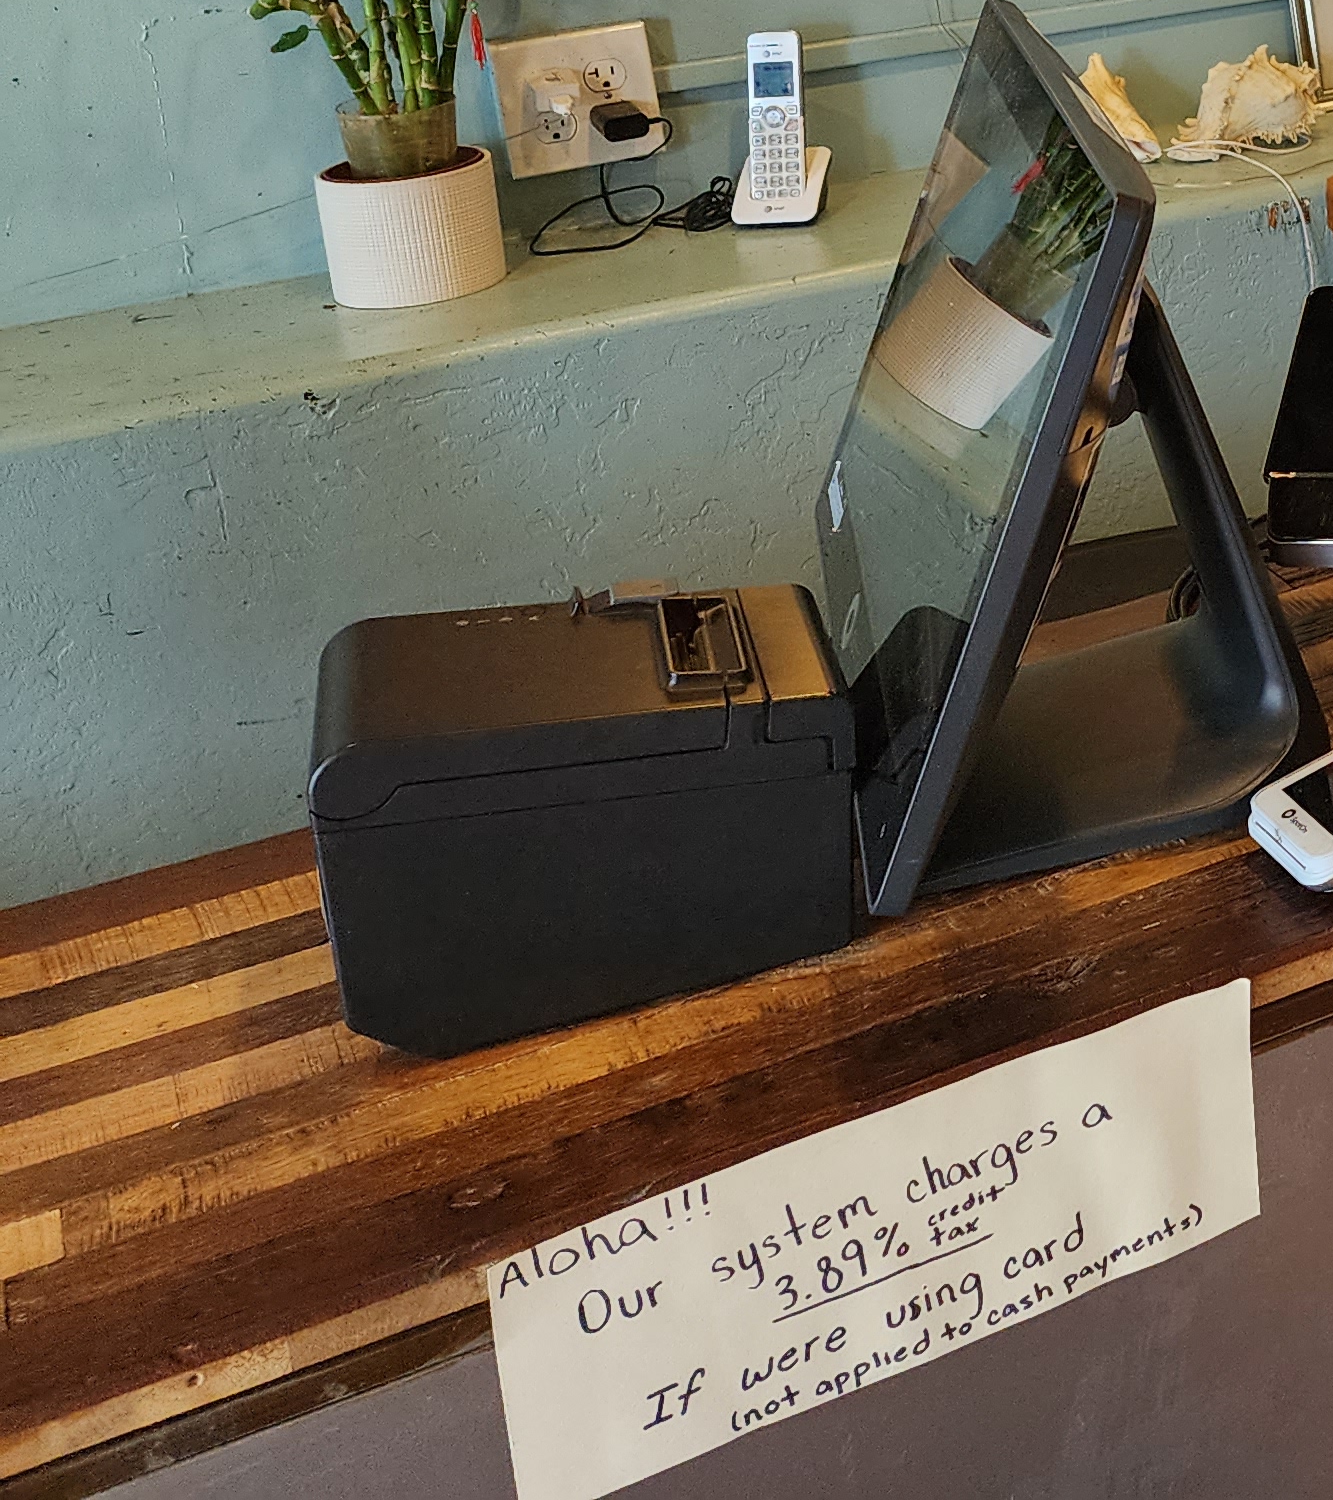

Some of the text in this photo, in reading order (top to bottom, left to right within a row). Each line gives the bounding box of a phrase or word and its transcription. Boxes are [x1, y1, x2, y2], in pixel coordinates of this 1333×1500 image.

[500, 1182, 711, 1299] Aloha!!!
[577, 1102, 1113, 1334] Our system charges a
[642, 1210, 1085, 1431] If were using card
[731, 1203, 1203, 1432] (not applied to cash payments)
[773, 1185, 1005, 1311] 3.89% credit tax
